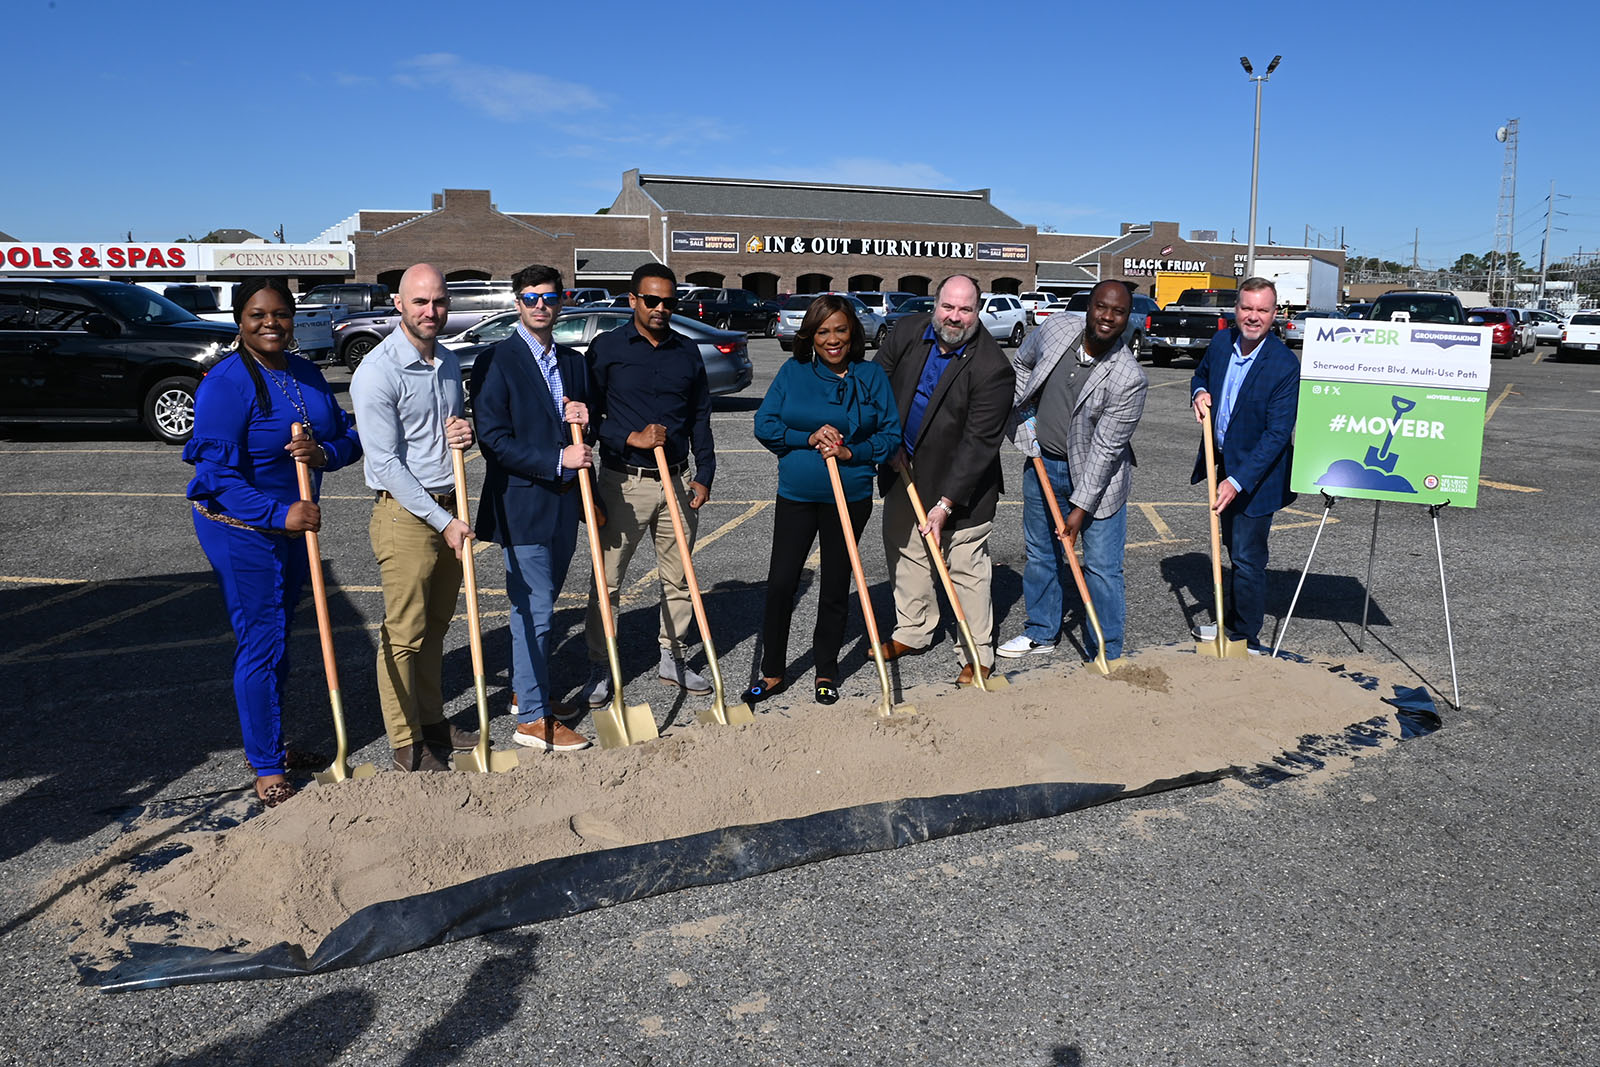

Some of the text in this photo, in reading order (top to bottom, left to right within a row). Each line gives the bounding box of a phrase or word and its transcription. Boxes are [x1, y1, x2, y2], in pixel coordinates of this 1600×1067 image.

[763, 235, 786, 253] IN
[791, 237, 806, 254] &
[811, 238, 850, 255] OUT
[860, 238, 974, 258] FURNITURE
[0, 247, 186, 268] OLS & SPAS
[236, 253, 328, 266] CENA'S NAILS
[1124, 258, 1206, 272] BLACK FRIDAY
[1316, 326, 1399, 345] MOVEBR
[1415, 332, 1478, 342] GROUNDBREAKING
[1313, 360, 1478, 380] Sherwood Forest Blvd. Multi-Use Path
[1329, 414, 1446, 440] #MOVEBR
